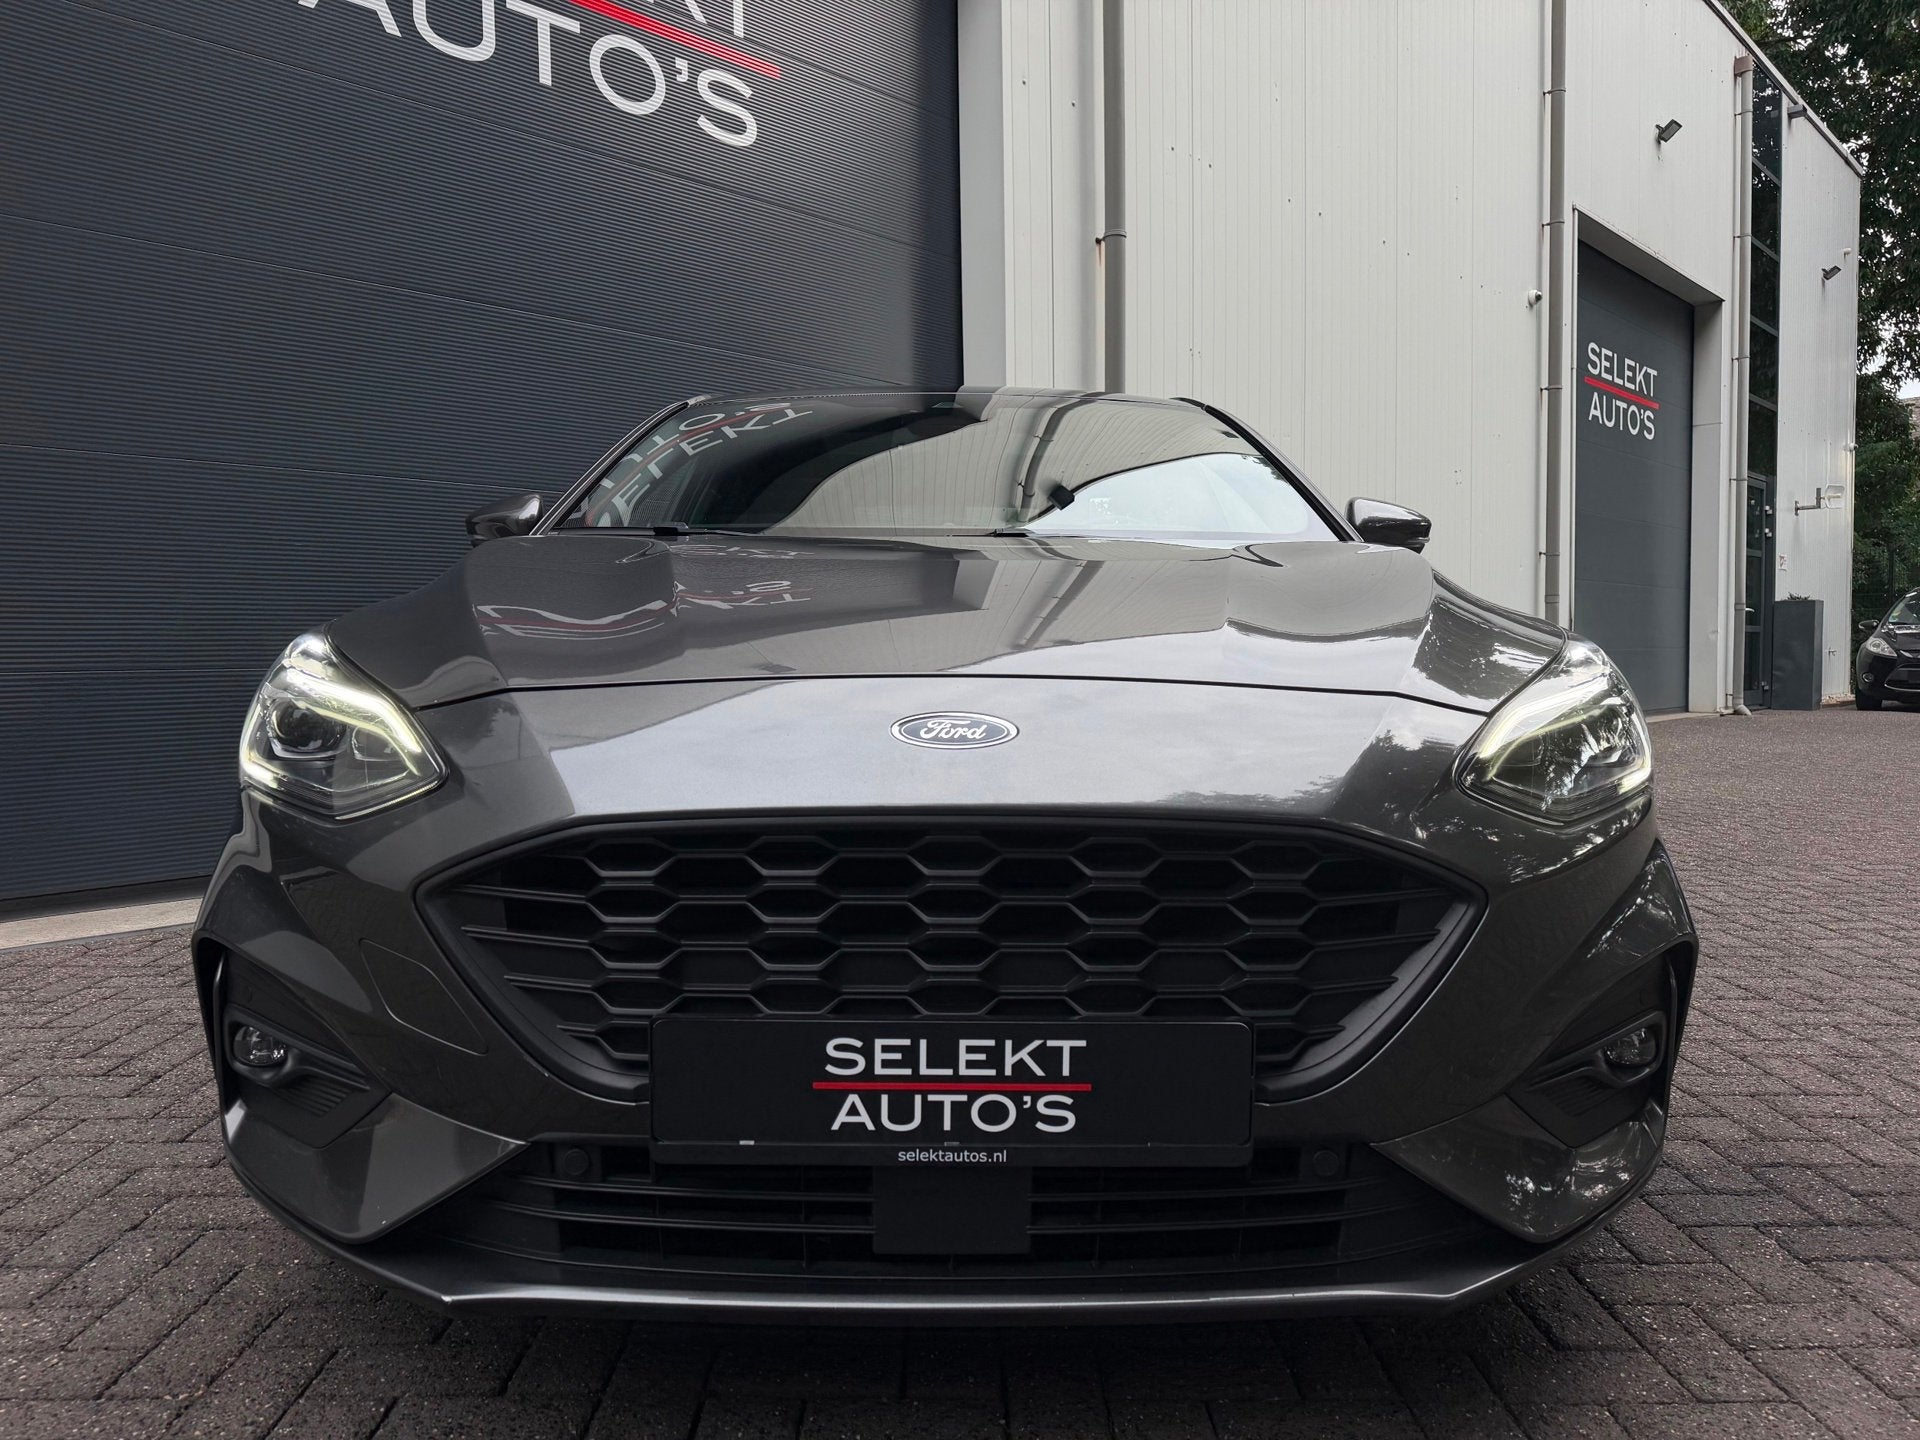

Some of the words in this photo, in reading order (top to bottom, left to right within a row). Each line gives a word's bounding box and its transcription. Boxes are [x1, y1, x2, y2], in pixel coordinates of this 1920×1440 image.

[1587, 341, 1658, 397] SELEKT
[1588, 391, 1655, 440] AUTO'S
[919, 718, 988, 740] Ford
[824, 1037, 1087, 1077] SELEKT
[830, 1093, 1077, 1133] AUTO'S
[898, 1148, 1007, 1162] selektautos.nl
